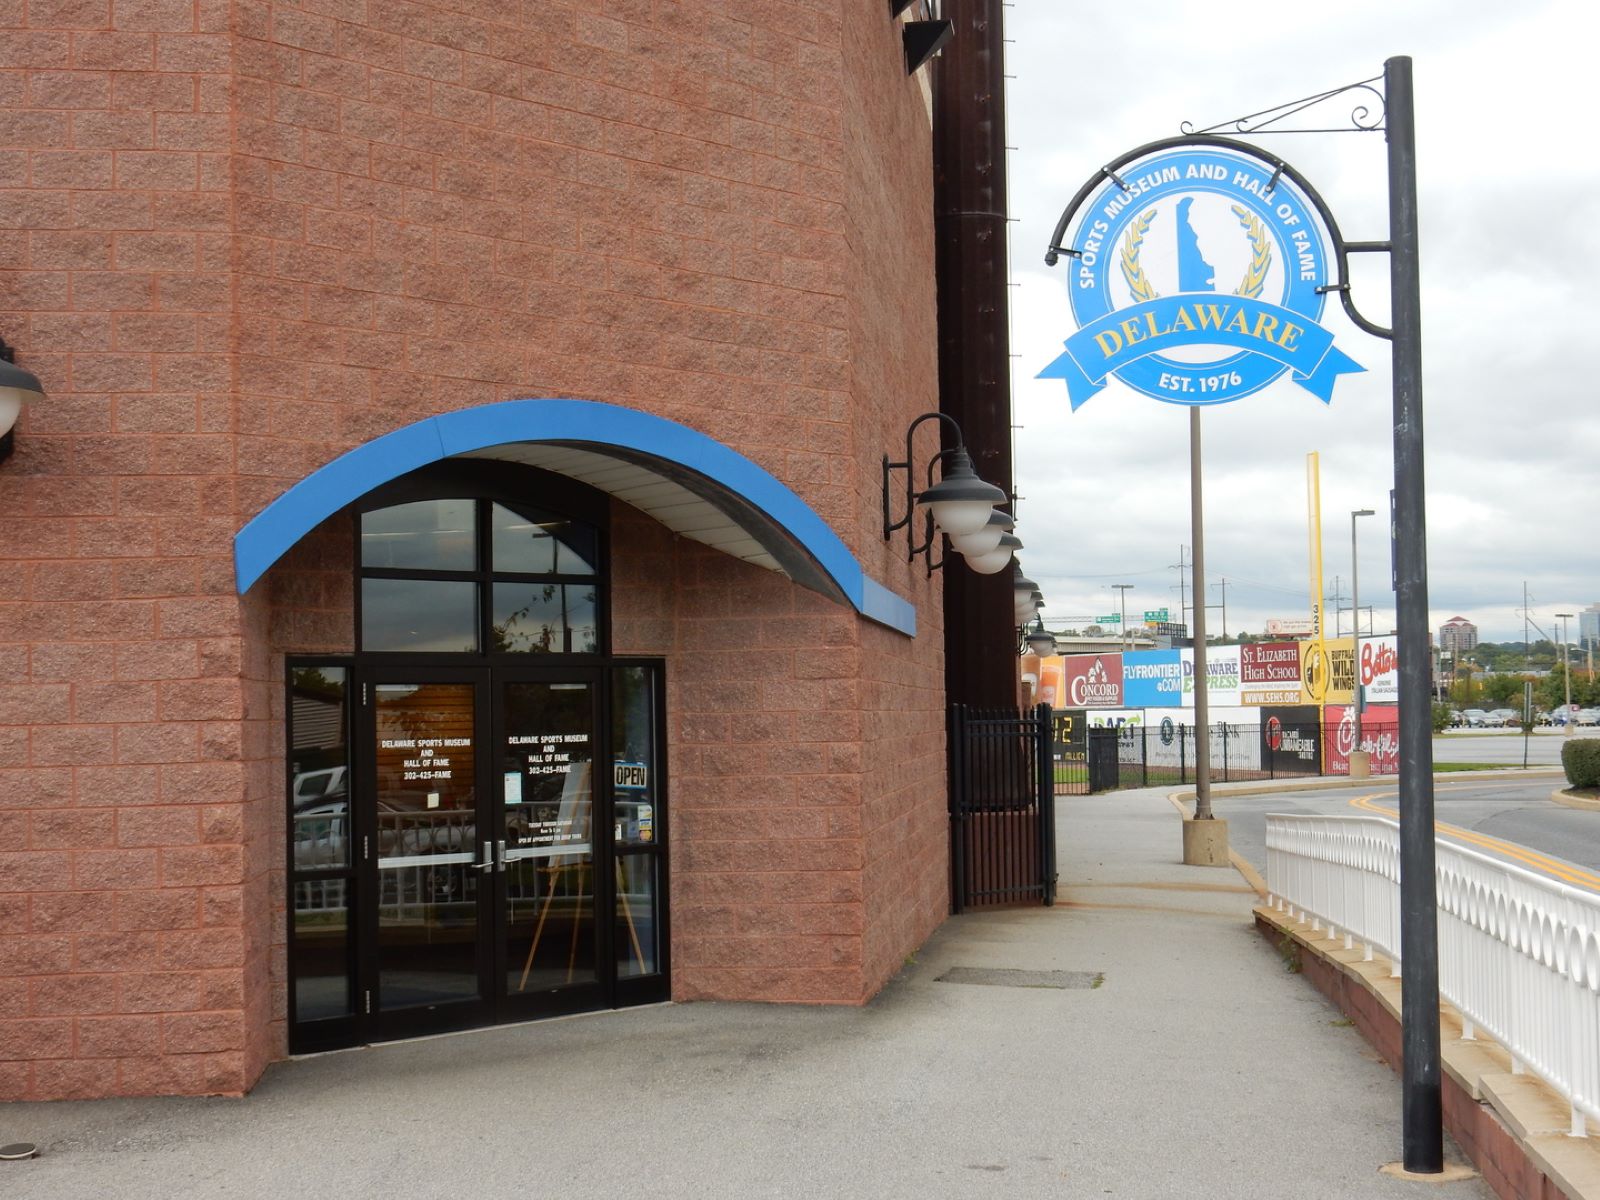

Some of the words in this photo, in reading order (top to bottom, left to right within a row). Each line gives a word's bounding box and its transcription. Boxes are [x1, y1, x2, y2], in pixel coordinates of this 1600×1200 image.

[1079, 220, 1109, 289] SPORTS
[1104, 165, 1181, 218] MUSEUM
[1185, 164, 1228, 181] AND
[1233, 171, 1279, 207] HALL
[1275, 202, 1299, 227] OF
[1291, 224, 1316, 282] FAME
[1092, 303, 1305, 360] DELAWARE
[1158, 372, 1195, 392] EST.
[1199, 371, 1243, 392] 1976
[1331, 649, 1355, 660] BUFFAL
[382, 740, 415, 748] DELAWARE
[417, 739, 442, 747] SPORTS
[444, 738, 470, 746] MUSEUM
[508, 736, 539, 744] DELAWARE
[541, 735, 562, 743] SPORTS
[564, 734, 588, 742] MUSEUM
[421, 749, 433, 757] AND
[543, 745, 555, 753] AND
[528, 754, 543, 762] HALL
[545, 754, 553, 762] OF
[554, 753, 569, 762] FAME
[404, 759, 420, 768] HALL
[422, 759, 431, 767] OF
[433, 758, 449, 766] FAME
[616, 767, 645, 785] OPEN
